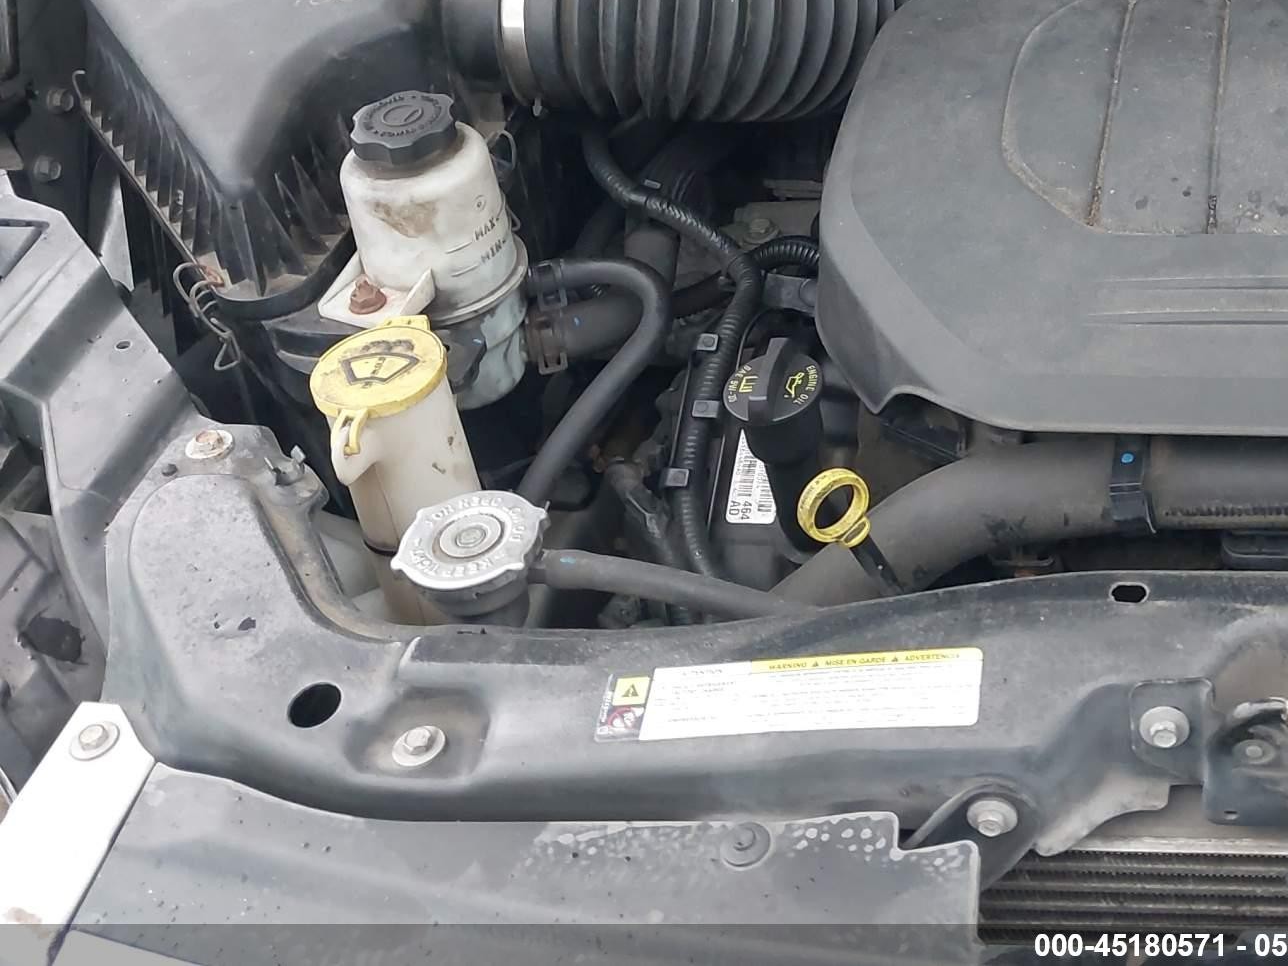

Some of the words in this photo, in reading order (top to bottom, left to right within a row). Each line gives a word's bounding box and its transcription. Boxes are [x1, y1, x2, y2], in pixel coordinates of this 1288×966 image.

[805, 364, 818, 392] ENGINE
[792, 393, 809, 405] OIL
[740, 500, 753, 521] 464
